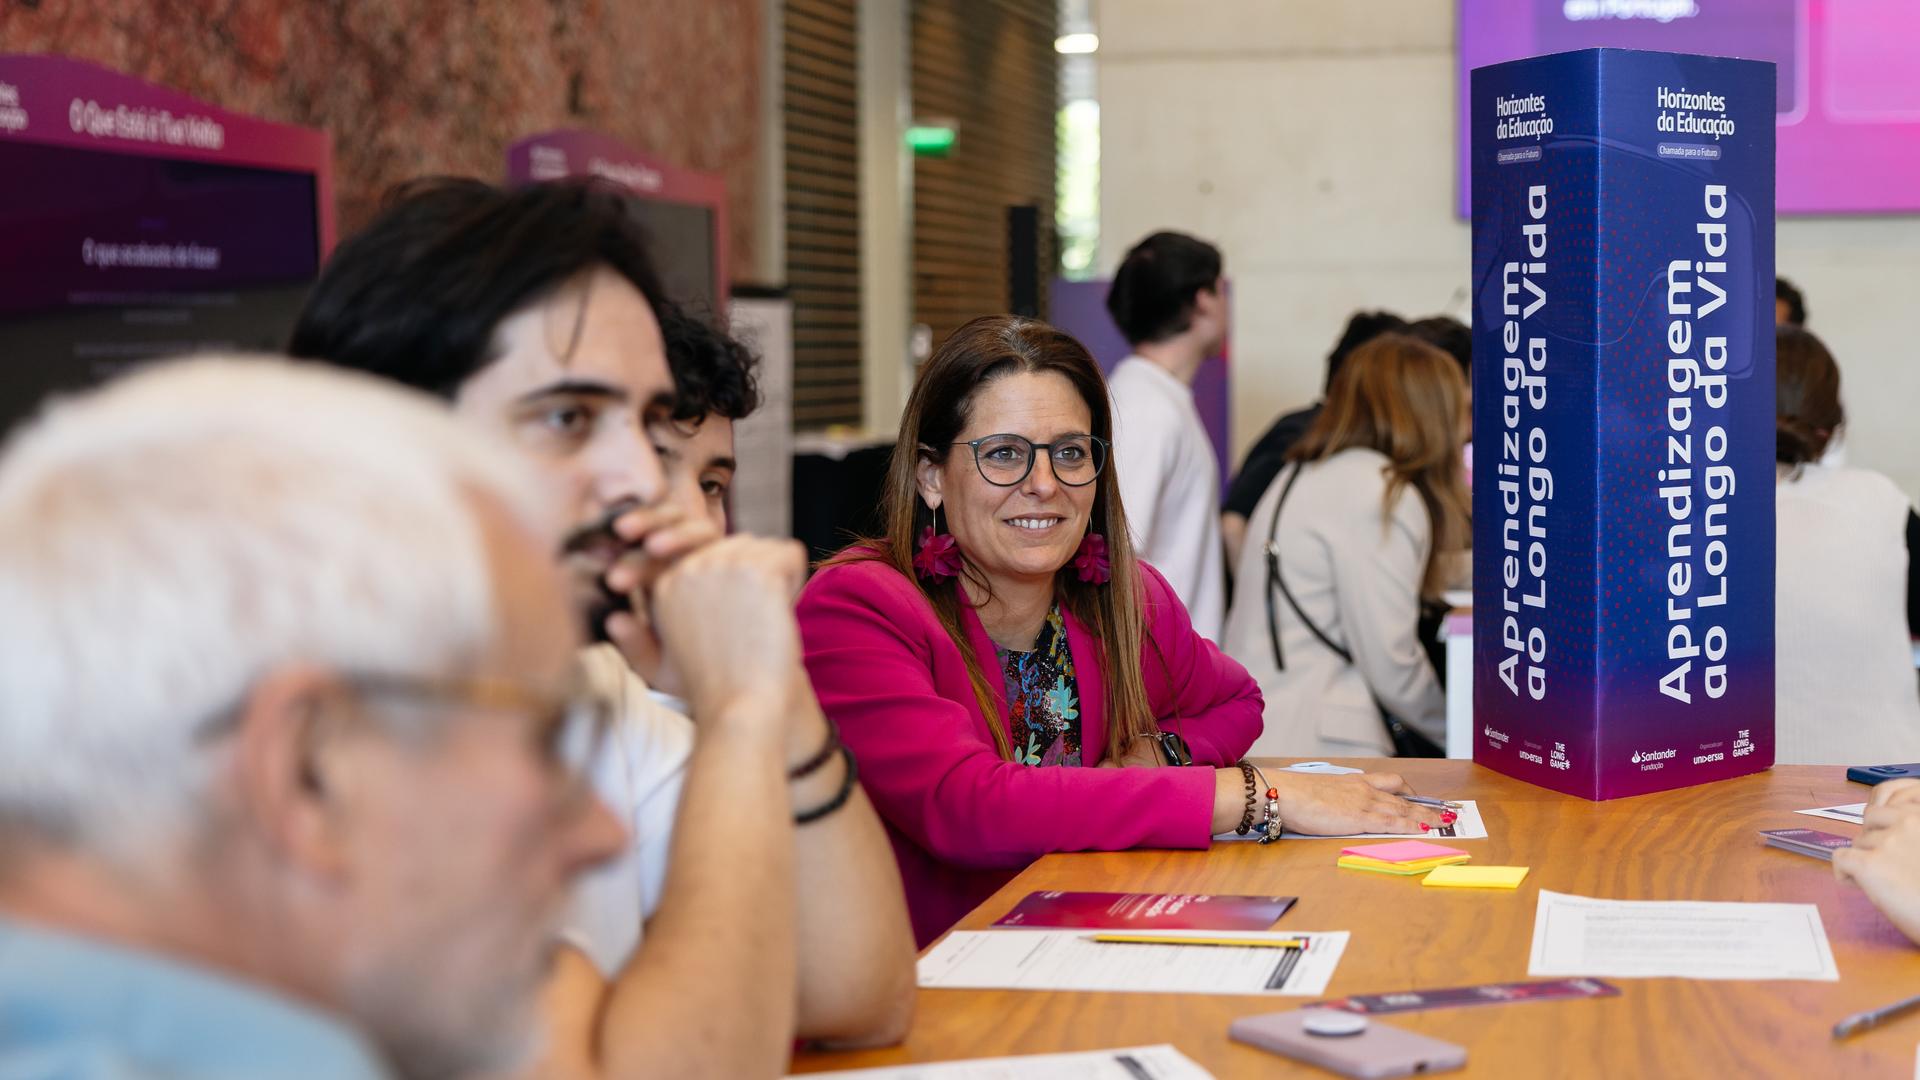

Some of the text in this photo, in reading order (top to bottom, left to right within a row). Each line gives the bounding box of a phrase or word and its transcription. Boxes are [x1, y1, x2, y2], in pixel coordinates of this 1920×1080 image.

[1497, 93, 1546, 117] Horizontes
[1657, 86, 1725, 112] Horizontes
[1497, 113, 1553, 140] da Educação
[1657, 111, 1735, 140] da Educação
[1659, 145, 1684, 156] Chamada
[1685, 149, 1696, 158] para
[1701, 147, 1718, 157] Futuro
[1522, 185, 1554, 700] ao Longo da Vida
[1694, 185, 1736, 699] ao Longo da Vida
[1498, 262, 1525, 697] Aprendizagem
[1658, 259, 1700, 704] Aprendizagem
[1733, 738, 1750, 749] LONG
[1738, 729, 1750, 739] THE
[1550, 750, 1566, 761] LONG
[1555, 742, 1566, 752] THE
[1641, 748, 1677, 763] Santander
